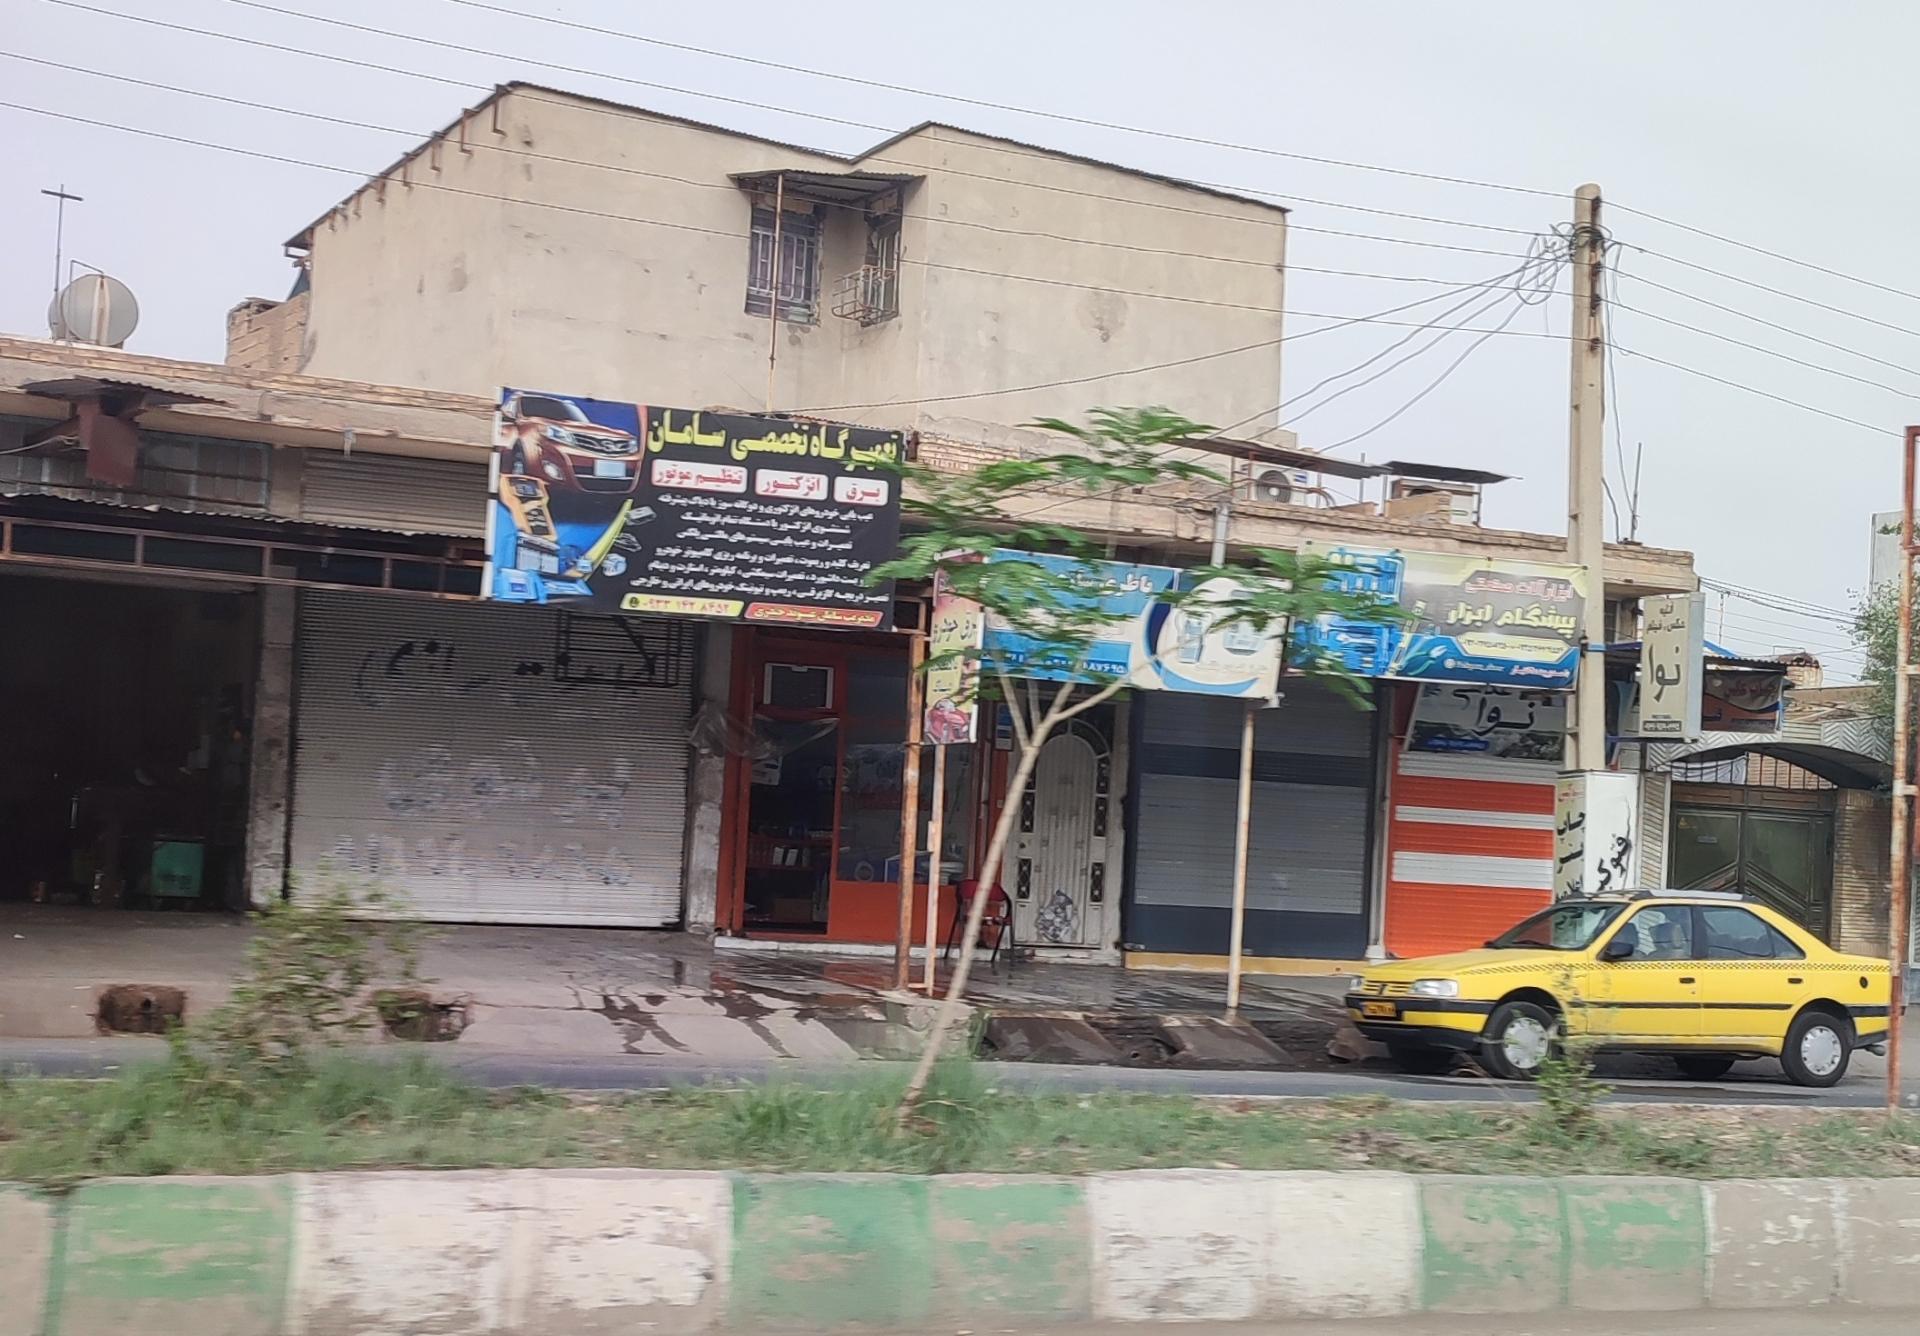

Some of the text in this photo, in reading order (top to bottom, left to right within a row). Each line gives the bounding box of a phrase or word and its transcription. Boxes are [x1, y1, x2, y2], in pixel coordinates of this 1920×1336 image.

[647, 409, 726, 453] سامان
[731, 422, 809, 461] تخصصی
[655, 463, 692, 485] موتور
[696, 468, 743, 487] تنظیم
[846, 483, 880, 502] برق
[1446, 601, 1577, 639] پیشگام ابزار
[1649, 643, 1681, 703] نوا
[1472, 697, 1535, 737] نوا
